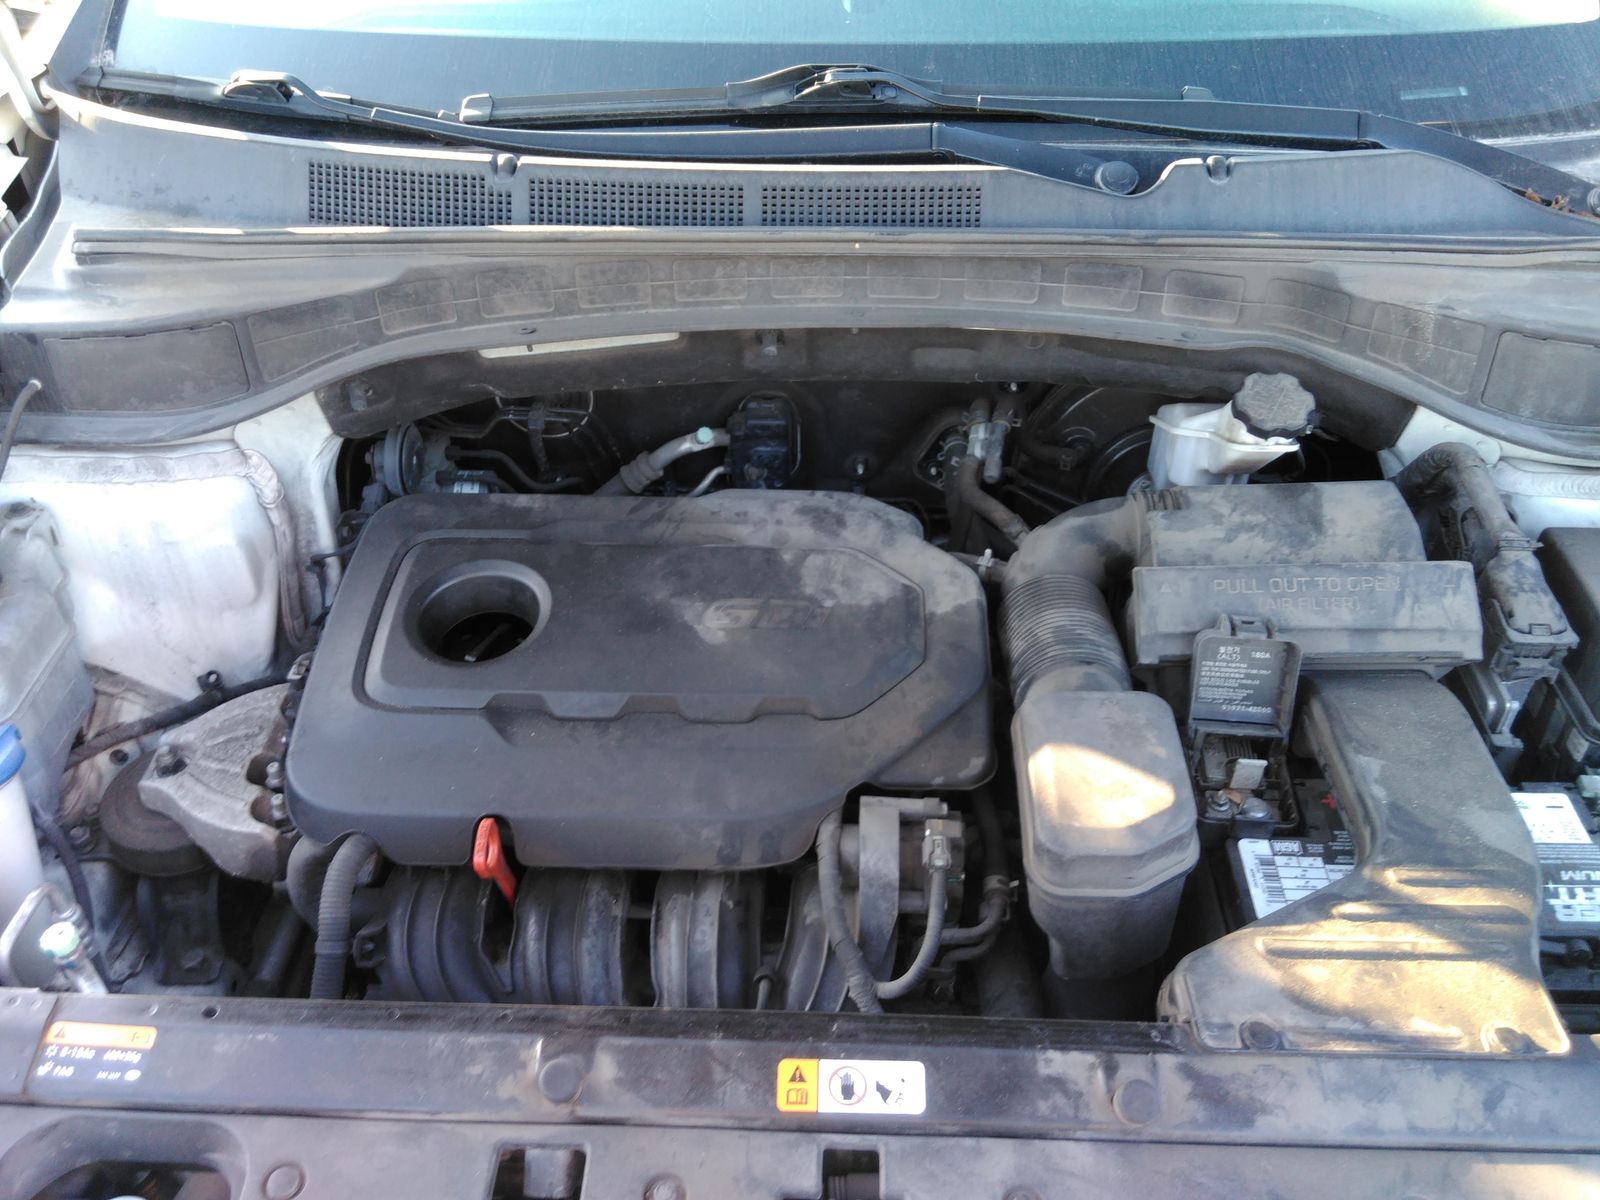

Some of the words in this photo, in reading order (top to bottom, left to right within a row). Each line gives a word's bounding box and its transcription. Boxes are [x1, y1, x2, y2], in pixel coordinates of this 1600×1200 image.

[1213, 578, 1264, 593] PULL
[1269, 577, 1310, 593] OUT
[1314, 577, 1341, 592] TO
[1347, 576, 1401, 592] OPEN
[1258, 597, 1294, 610] (AIR
[1298, 597, 1361, 611] FILTER)
